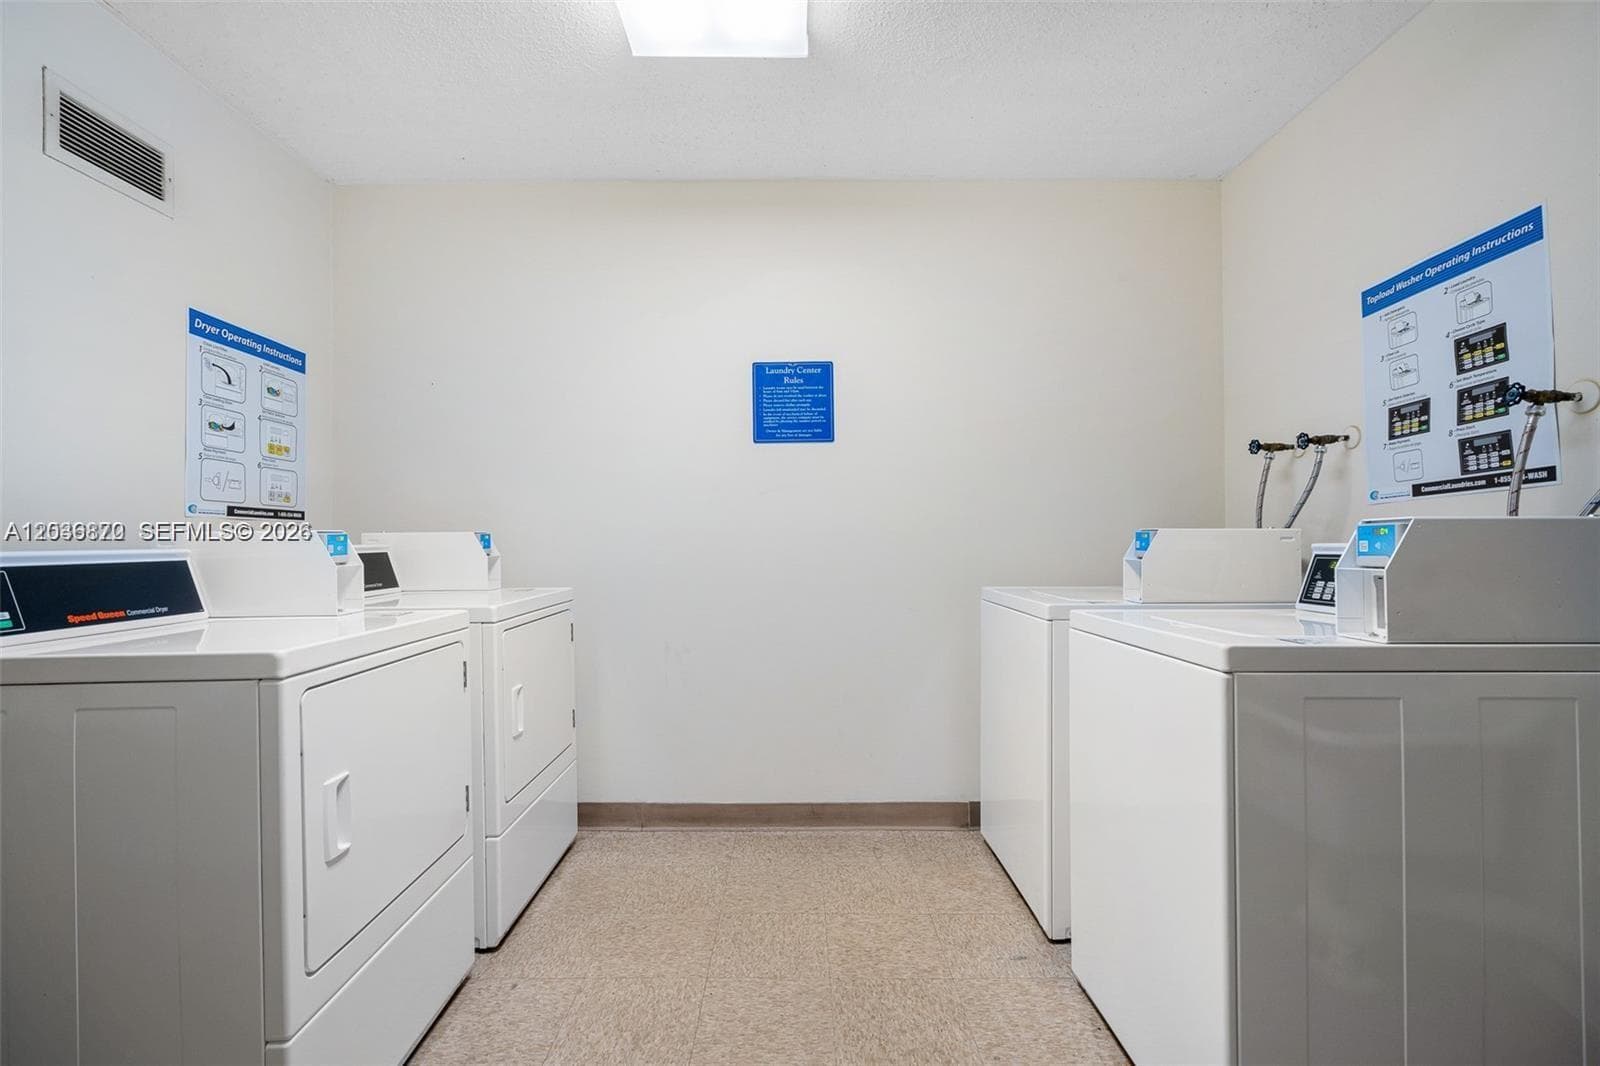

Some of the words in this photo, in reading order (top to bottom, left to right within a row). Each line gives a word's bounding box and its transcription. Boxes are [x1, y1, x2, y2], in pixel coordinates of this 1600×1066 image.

[1366, 285, 1395, 305] Topload
[1395, 272, 1424, 292] Washer
[1424, 250, 1471, 279] Operating
[1471, 221, 1534, 257] Instructions
[194, 318, 220, 336] Dryer
[221, 328, 263, 352] Operating
[263, 344, 302, 367] Instructions
[765, 366, 795, 375] Laundry
[796, 366, 822, 374] Center
[783, 376, 804, 384] Rules
[67, 612, 97, 624] Speed
[97, 610, 126, 620] Queen
[126, 607, 155, 616] Commercial
